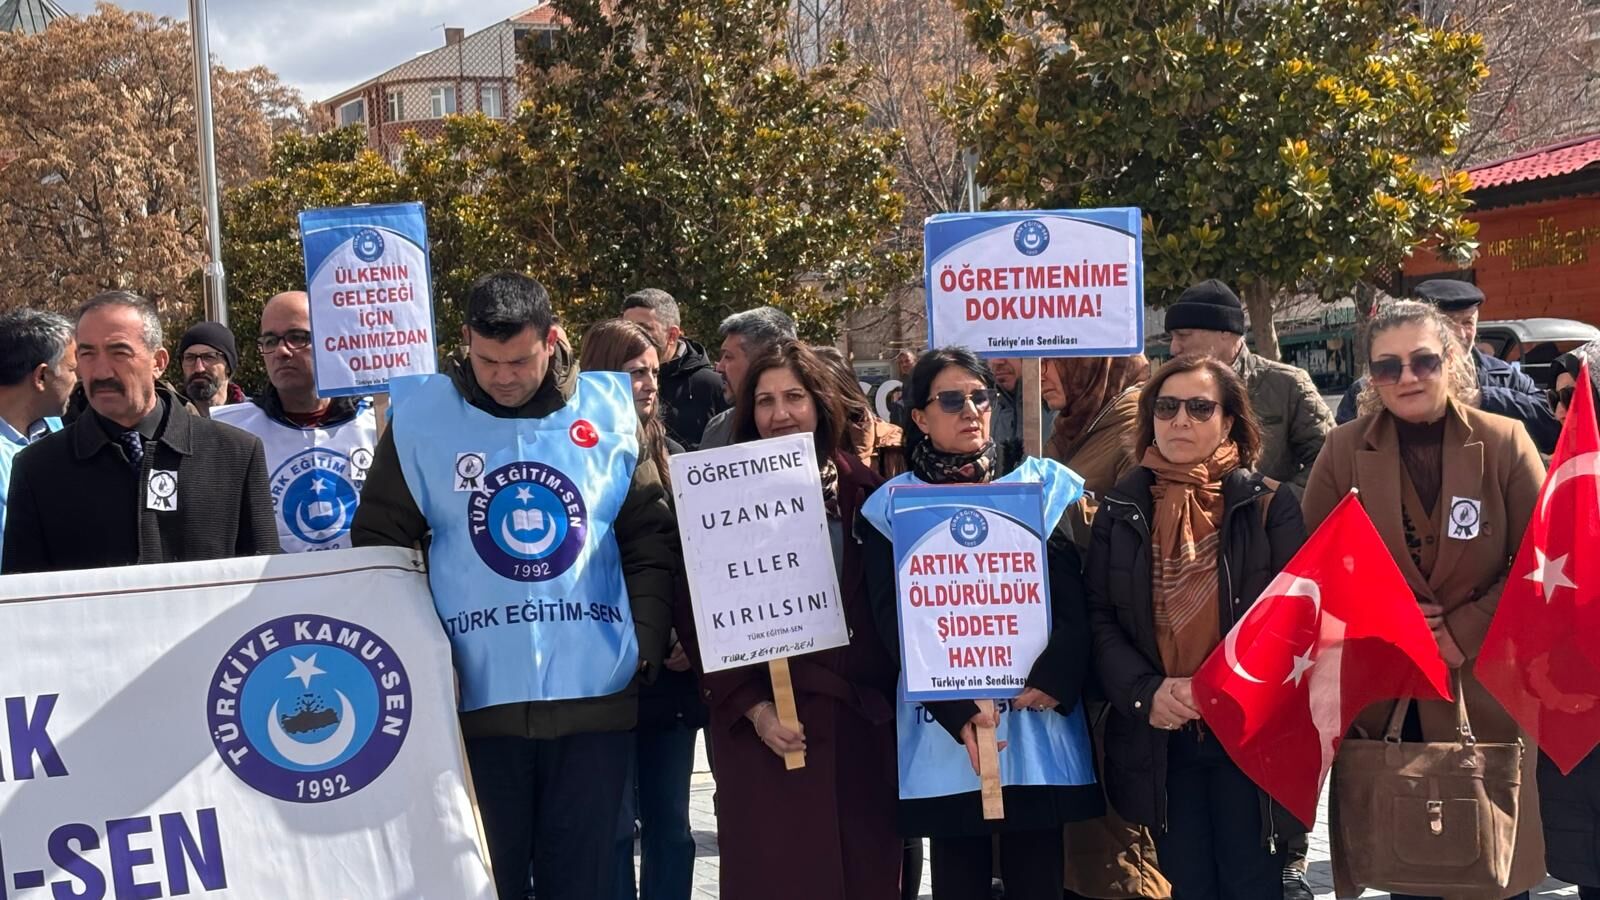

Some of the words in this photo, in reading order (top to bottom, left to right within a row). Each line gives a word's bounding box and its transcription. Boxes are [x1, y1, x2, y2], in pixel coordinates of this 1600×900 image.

[335, 264, 409, 285] ÜLKENİN
[939, 259, 1128, 292] ÖĞRETMENİME
[332, 283, 414, 307] GELECEĞİ
[965, 294, 1102, 321] DOKUNMA!
[360, 308, 394, 330] İÇİN
[324, 329, 428, 352] CANIMIZDAN
[988, 336, 1034, 349] Türkiye'nin
[1036, 335, 1078, 347] Sendikası
[349, 352, 411, 372] OLDUK!
[687, 451, 803, 486] ÖĞRETMENE
[470, 482, 496, 535] TÜRK
[496, 465, 582, 528] EĞİTİM-SEN
[701, 496, 805, 530] UZANAN
[513, 562, 552, 578] 1992
[727, 552, 800, 579] ELLER
[909, 553, 969, 576] ARTIK
[973, 552, 1037, 574] YETER
[909, 578, 1041, 608] ÖLDÜRÜLDÜK
[447, 607, 500, 638] TÜRK
[505, 598, 624, 625] EĞİTİM-SEN
[712, 591, 828, 630] KIRILSIN!
[747, 632, 765, 641] TÜRK
[766, 625, 803, 638] EĞİTİM-SEN
[937, 611, 1019, 643] ŞİDDETE
[948, 645, 1013, 668] HAYIR!
[214, 628, 280, 766] TÜRKİYE
[293, 620, 405, 737] KAMU-SEN
[931, 676, 983, 690] Türkiye'nin
[0, 693, 69, 782] K
[296, 774, 351, 799] 1992
